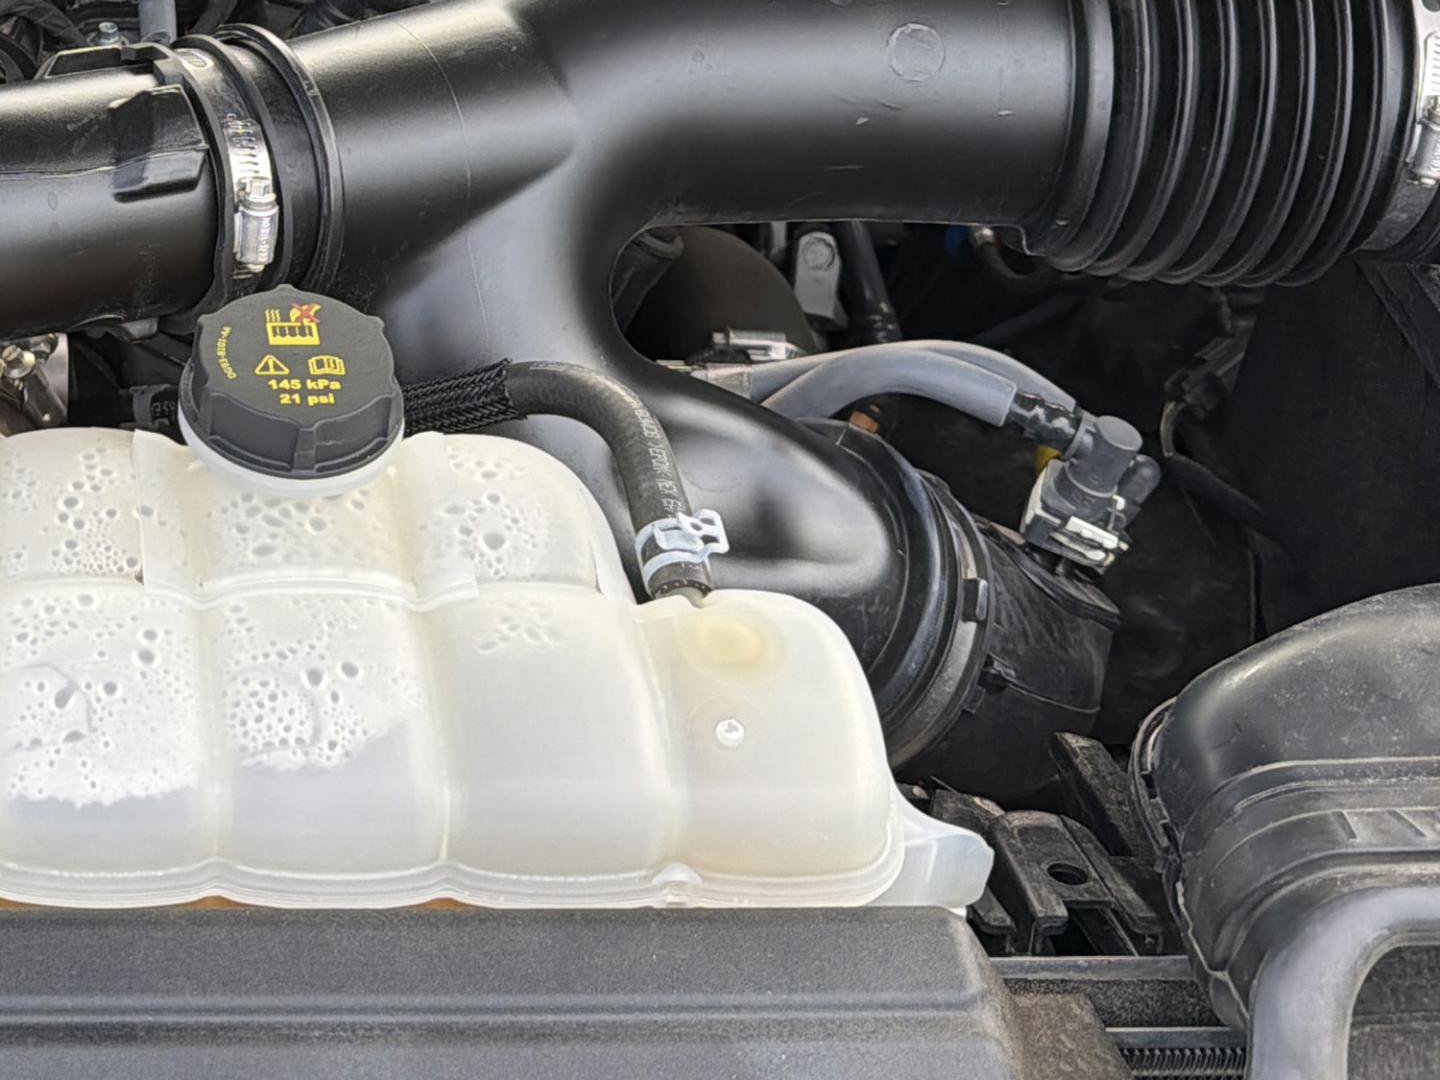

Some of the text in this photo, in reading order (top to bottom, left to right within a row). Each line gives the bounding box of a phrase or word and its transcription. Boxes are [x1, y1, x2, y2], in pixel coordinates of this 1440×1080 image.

[268, 379, 342, 390] 145 kPa
[280, 393, 336, 406] 21 psi
